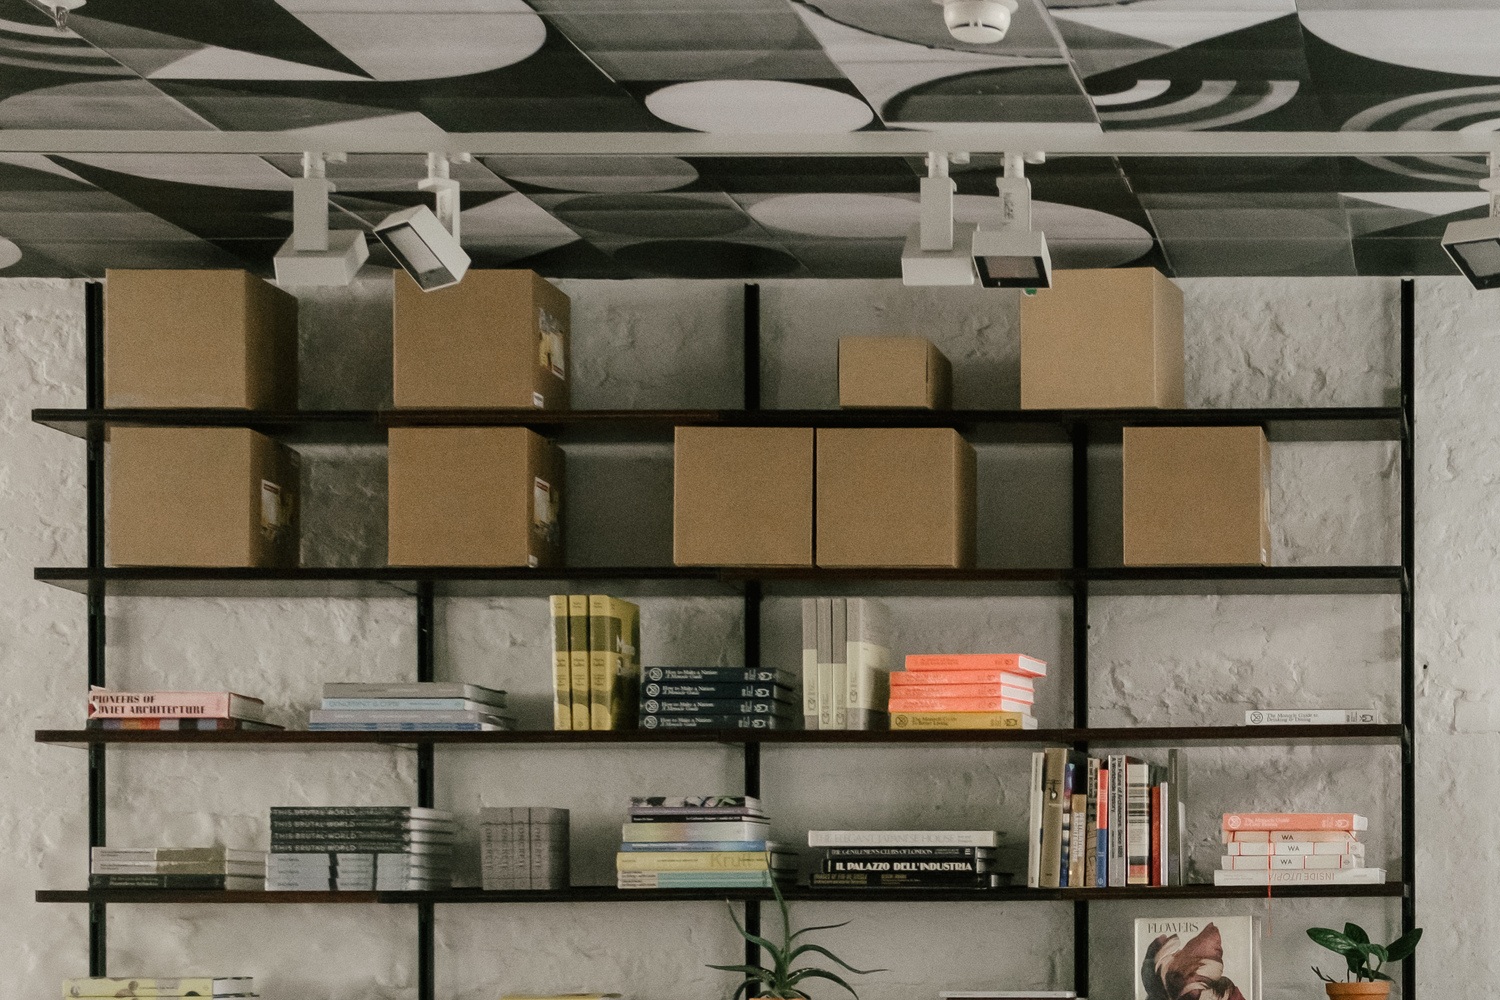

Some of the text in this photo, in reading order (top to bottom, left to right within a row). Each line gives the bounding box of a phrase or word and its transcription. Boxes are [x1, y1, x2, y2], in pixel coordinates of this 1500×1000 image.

[92, 695, 156, 704] PIONEERS OF
[98, 705, 206, 715] OVIET ARCHITECTURE
[836, 862, 972, 871] IL PALAZZO DELL'INDUSTRIA
[1269, 873, 1302, 881] UTOPIA
[1148, 922, 1199, 933] FLOWERS
